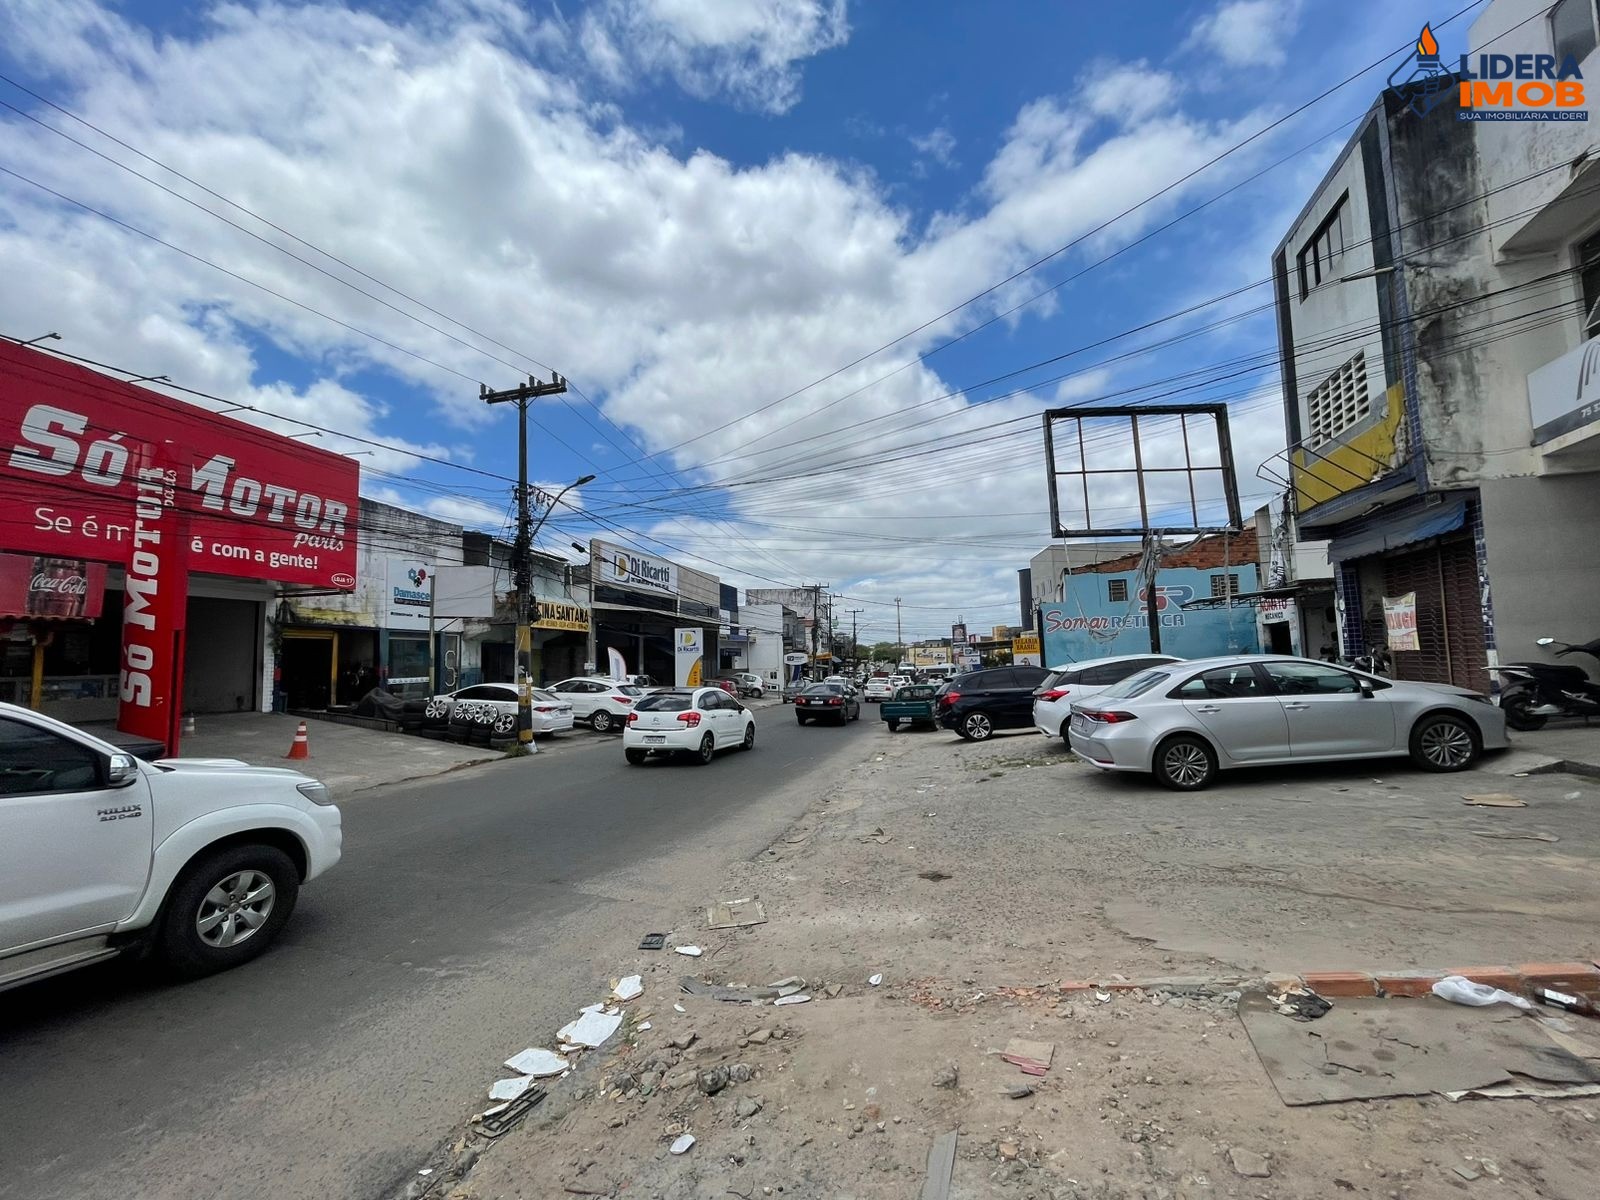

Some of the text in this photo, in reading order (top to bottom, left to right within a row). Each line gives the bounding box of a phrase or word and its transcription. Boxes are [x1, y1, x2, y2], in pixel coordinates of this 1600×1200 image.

[8, 404, 129, 487] Só
[35, 507, 72, 534] Se
[82, 515, 98, 537] é
[191, 536, 203, 553] é
[211, 542, 251, 560] com
[254, 550, 265, 562] a
[269, 551, 318, 570] gente!
[120, 466, 164, 707] Só MOTOR
[630, 557, 670, 583] Di Ricartti
[1044, 610, 1186, 634] Somar RETICA
[97, 804, 142, 816] HILUX
